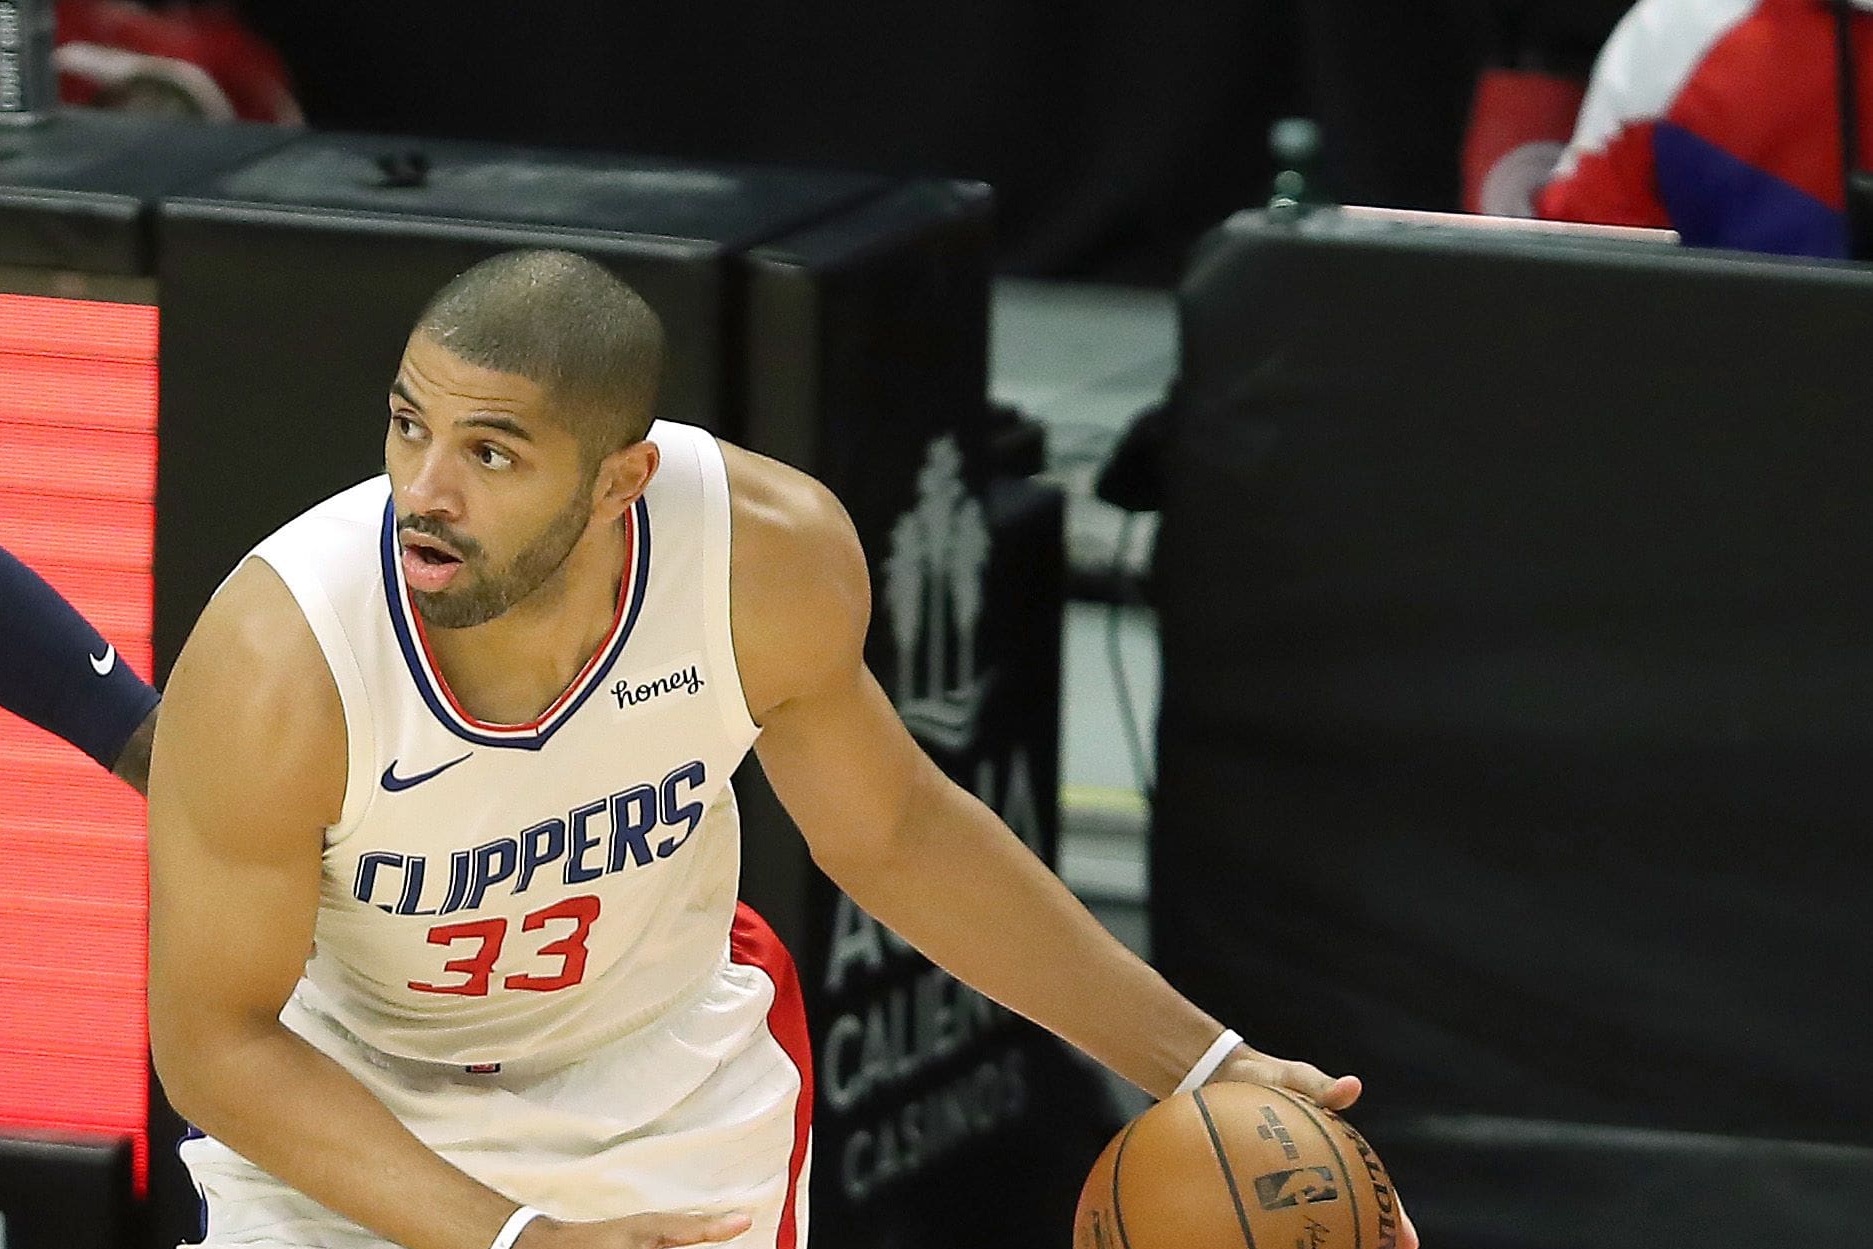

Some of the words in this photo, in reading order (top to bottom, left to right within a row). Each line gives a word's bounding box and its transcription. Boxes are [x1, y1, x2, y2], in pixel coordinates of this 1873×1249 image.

[611, 664, 705, 710] honey
[353, 760, 706, 916] CLIPPERS
[407, 895, 602, 998] 33
